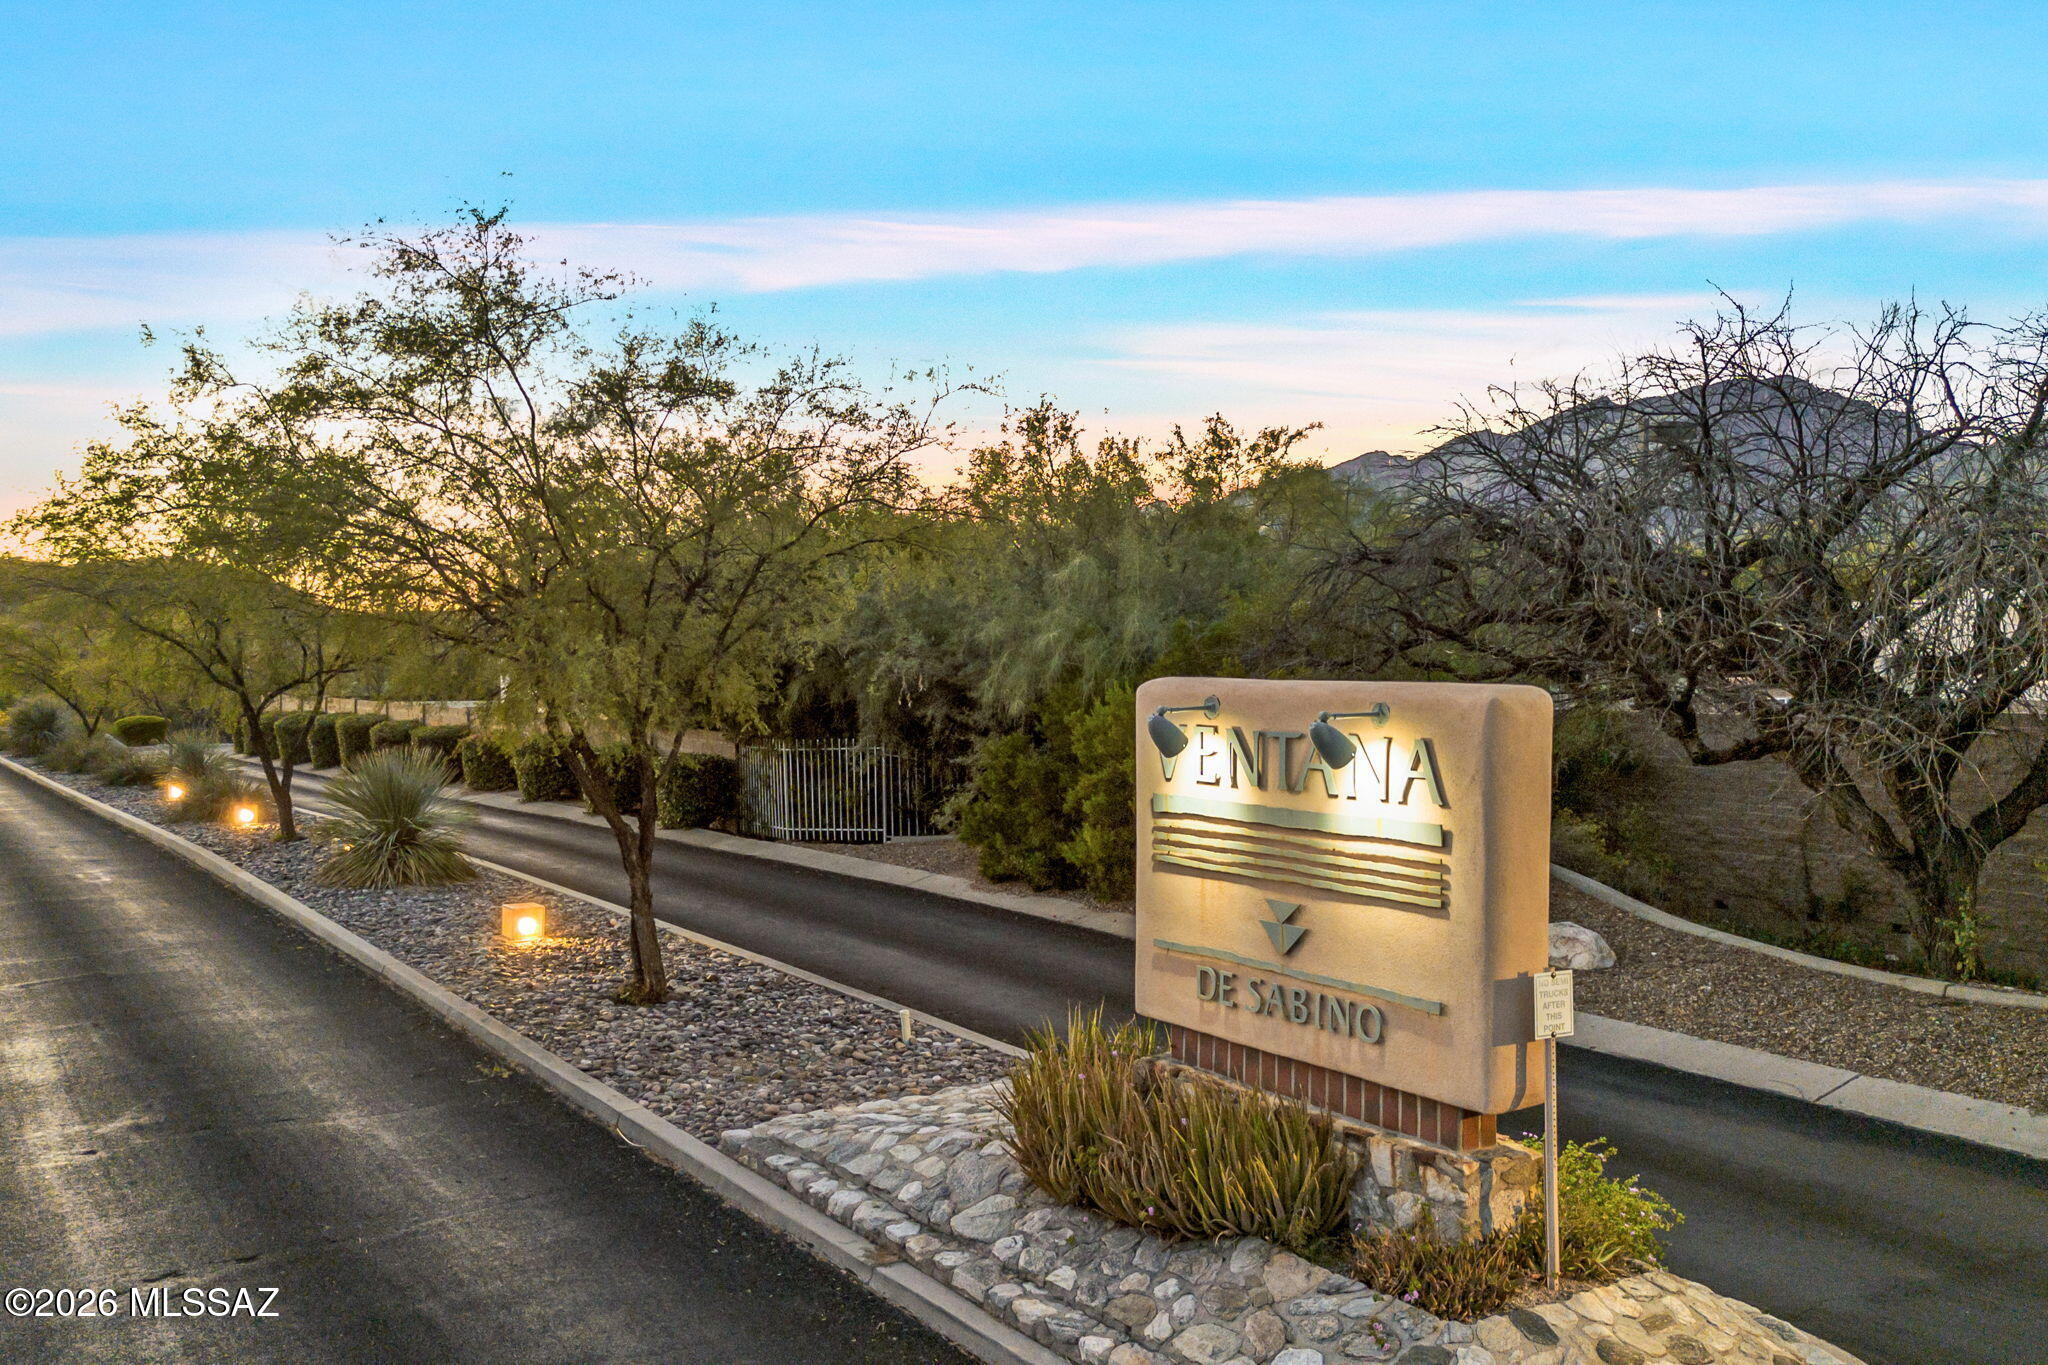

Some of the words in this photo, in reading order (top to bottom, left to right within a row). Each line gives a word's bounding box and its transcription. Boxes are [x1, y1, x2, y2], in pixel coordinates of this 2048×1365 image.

[1538, 979, 1549, 988] NO
[1551, 977, 1568, 986] SEMI
[1539, 989, 1568, 999] TRUCKS
[1196, 965, 1237, 1008] DE
[1244, 976, 1383, 1044] SABINO
[1543, 1000, 1565, 1010] AFTER
[1546, 1012, 1562, 1021] THIS
[1544, 1023, 1565, 1033] POINT
